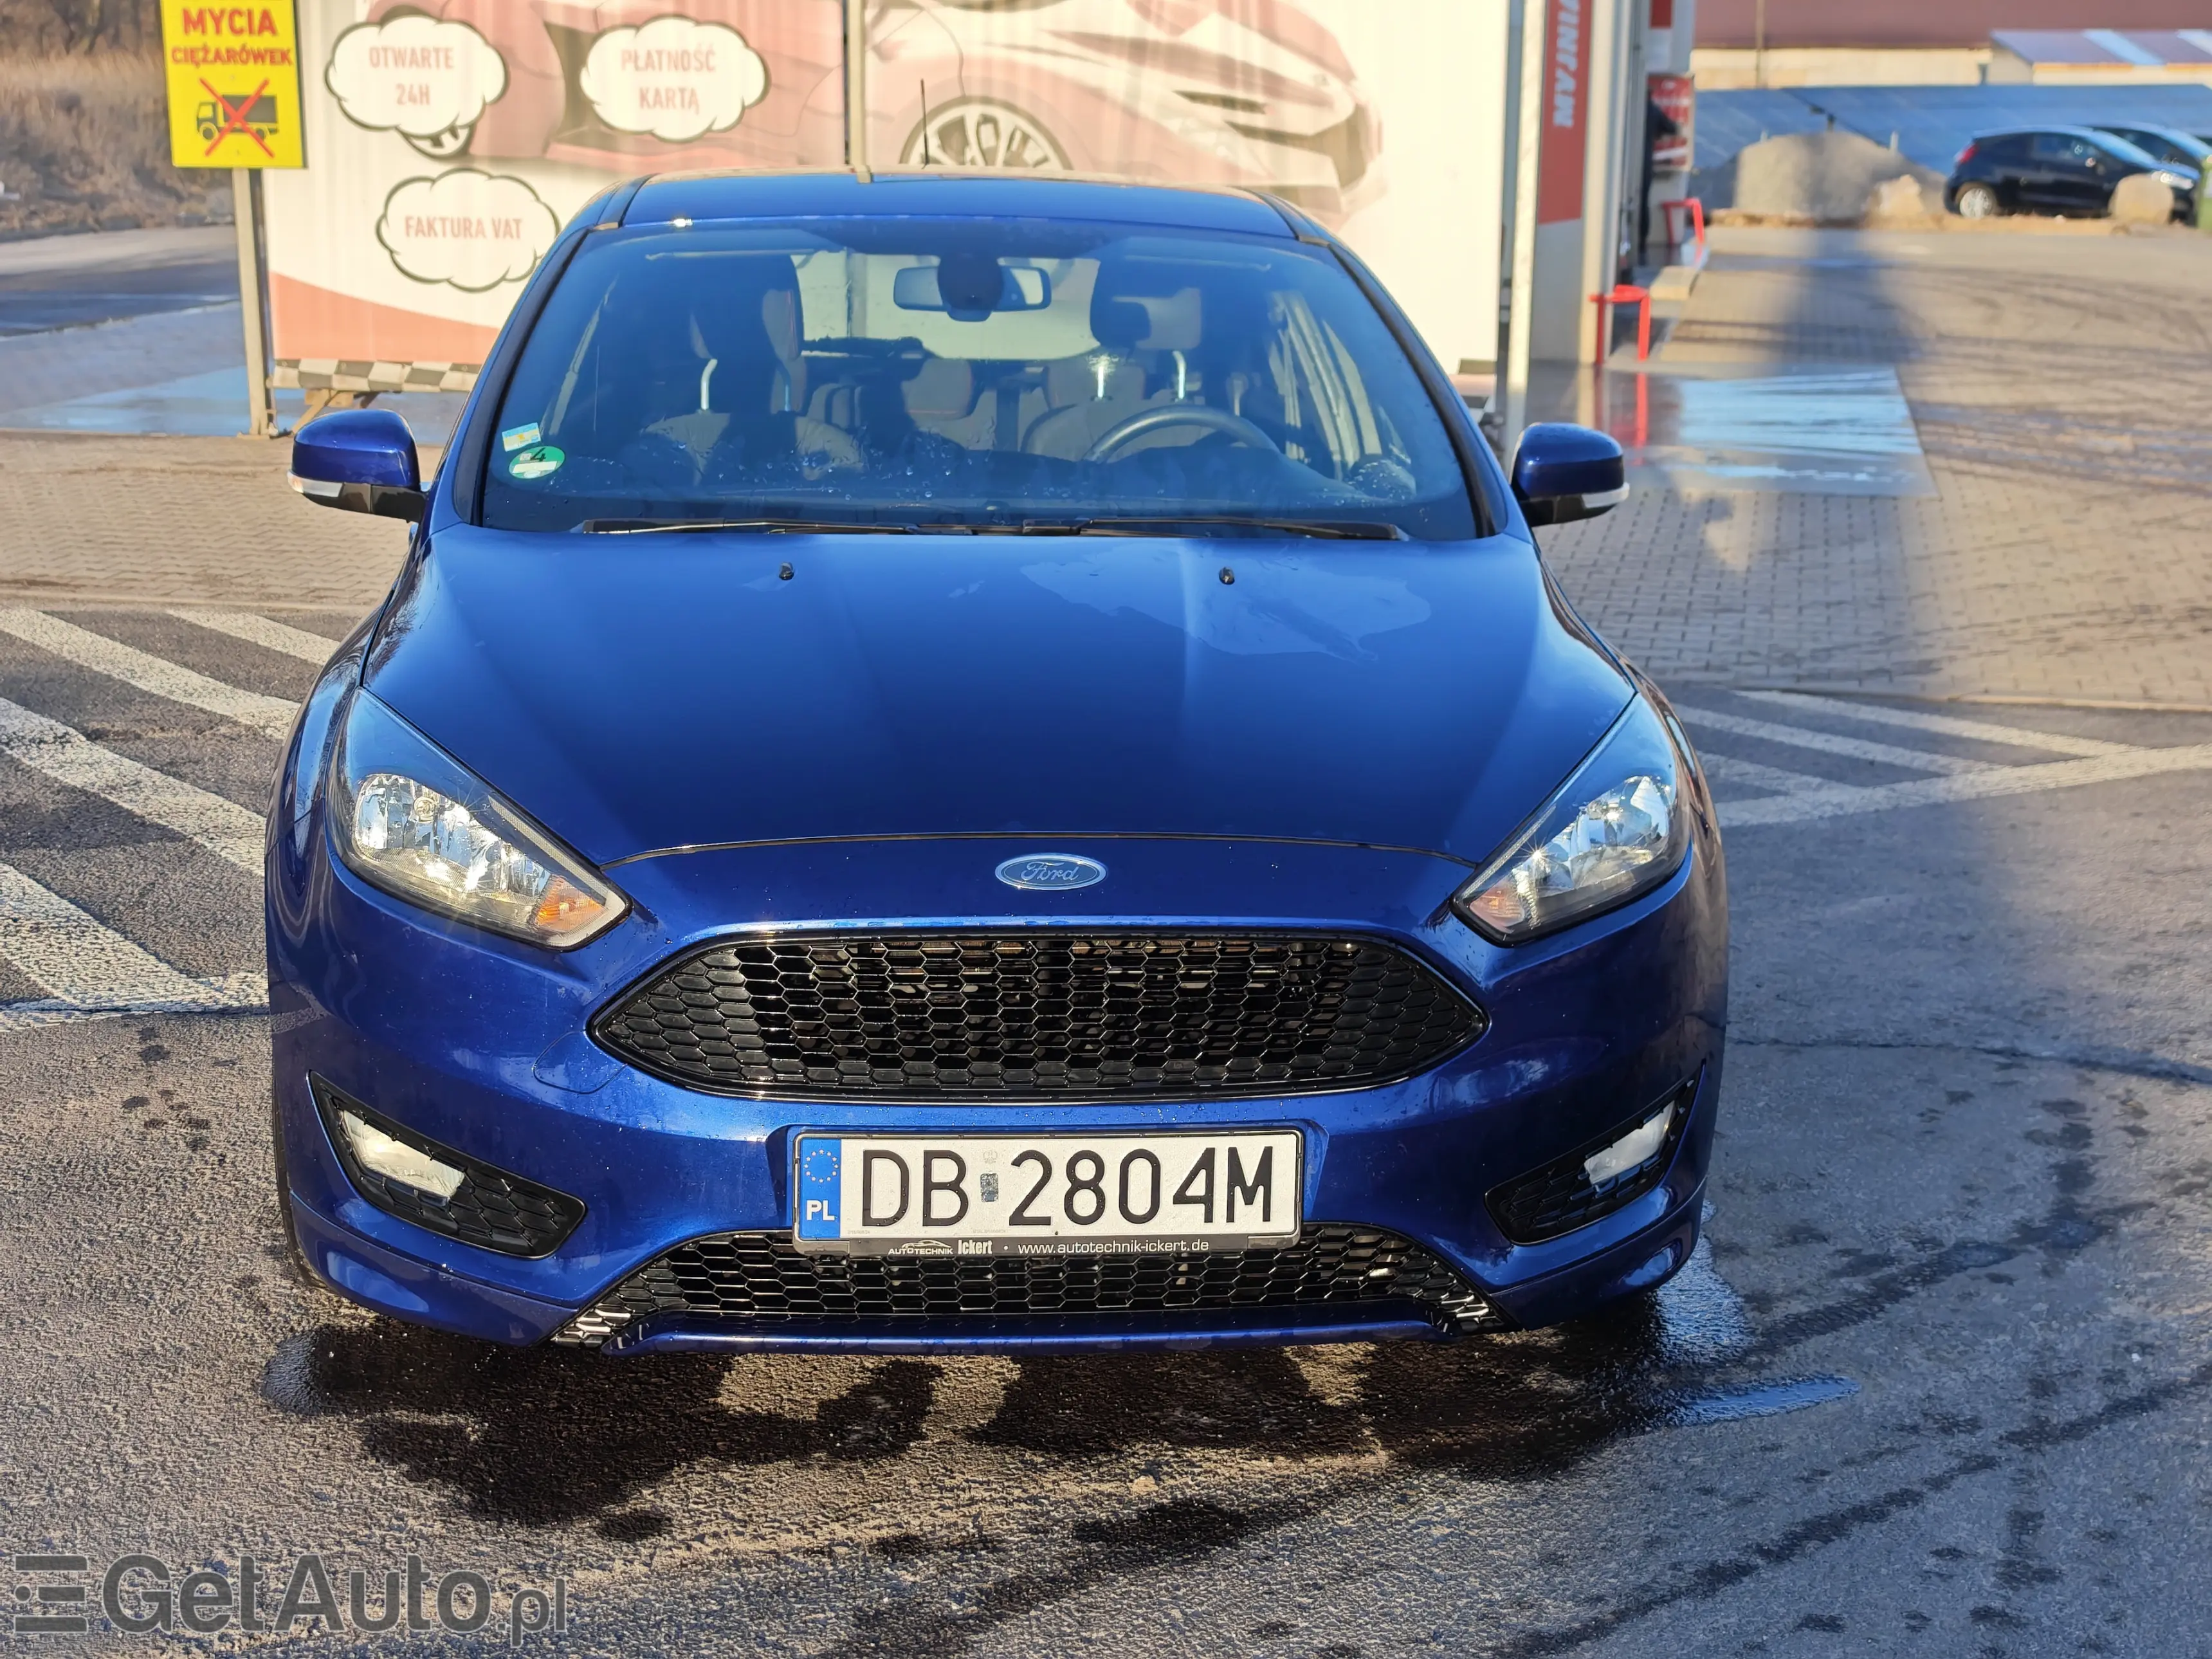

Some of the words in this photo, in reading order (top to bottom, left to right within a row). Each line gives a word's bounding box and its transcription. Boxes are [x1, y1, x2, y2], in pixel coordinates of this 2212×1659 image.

[183, 8, 278, 36] MYCIA
[172, 42, 293, 68] CIĘŻARÓWEK
[369, 46, 455, 69] OTWARTE
[621, 42, 716, 73] PŁATNOŚĆ
[395, 84, 431, 105] 24H
[639, 87, 700, 116] KARTĄ
[405, 215, 487, 239] FAKTURA
[491, 215, 524, 239] VAT
[530, 447, 546, 462] 4
[1020, 861, 1079, 881] Ford
[862, 1150, 969, 1227] DB
[1009, 1146, 1274, 1225] 2804M
[806, 1200, 836, 1221] PL
[888, 1247, 954, 1255] AUTOTECHNIK
[957, 1240, 993, 1254] Ickert
[1017, 1239, 1209, 1254] www.autotechnik-ickert.de
